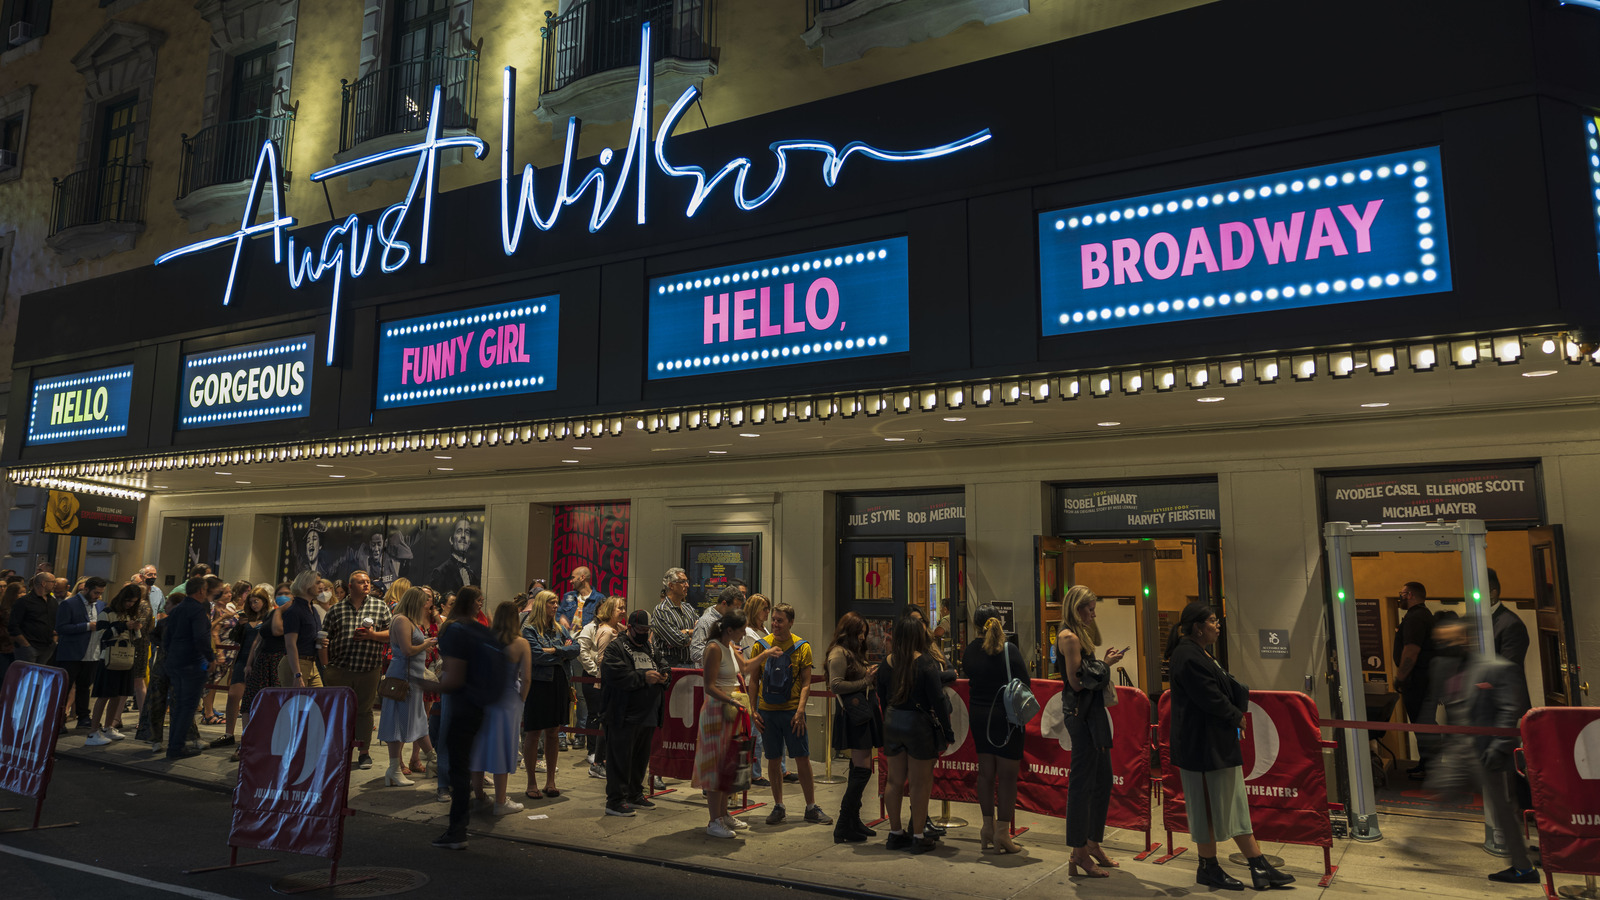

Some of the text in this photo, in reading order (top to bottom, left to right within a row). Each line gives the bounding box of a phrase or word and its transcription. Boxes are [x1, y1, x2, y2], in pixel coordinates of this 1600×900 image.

[500, 22, 992, 256] Wilson
[1080, 199, 1385, 290] BROADWAY
[703, 276, 847, 346] HELLO,
[401, 321, 531, 386] FUNNY GIRL
[189, 360, 306, 408] GORGEOUS
[50, 386, 109, 426] HELLO,
[1335, 479, 1526, 500] AYODELE CASEL ELLENORE SCOTT
[1064, 493, 1138, 510] ISOBEL LENNART
[1382, 502, 1478, 519] MICHAEL MAYER
[847, 509, 901, 526] JULE STYNE
[907, 506, 966, 524] BOB MERRIL
[1128, 508, 1216, 526] HARVEY FIERSTEIN
[554, 511, 630, 549] FUNNY GI
[553, 533, 629, 577] FUNNY GI
[662, 740, 695, 752] JUJAMCYN
[942, 760, 980, 771] THEATERS
[1028, 763, 1072, 777] JUJAMCY
[1246, 785, 1299, 798] THEATERS
[1570, 814, 1600, 826] JUJA
